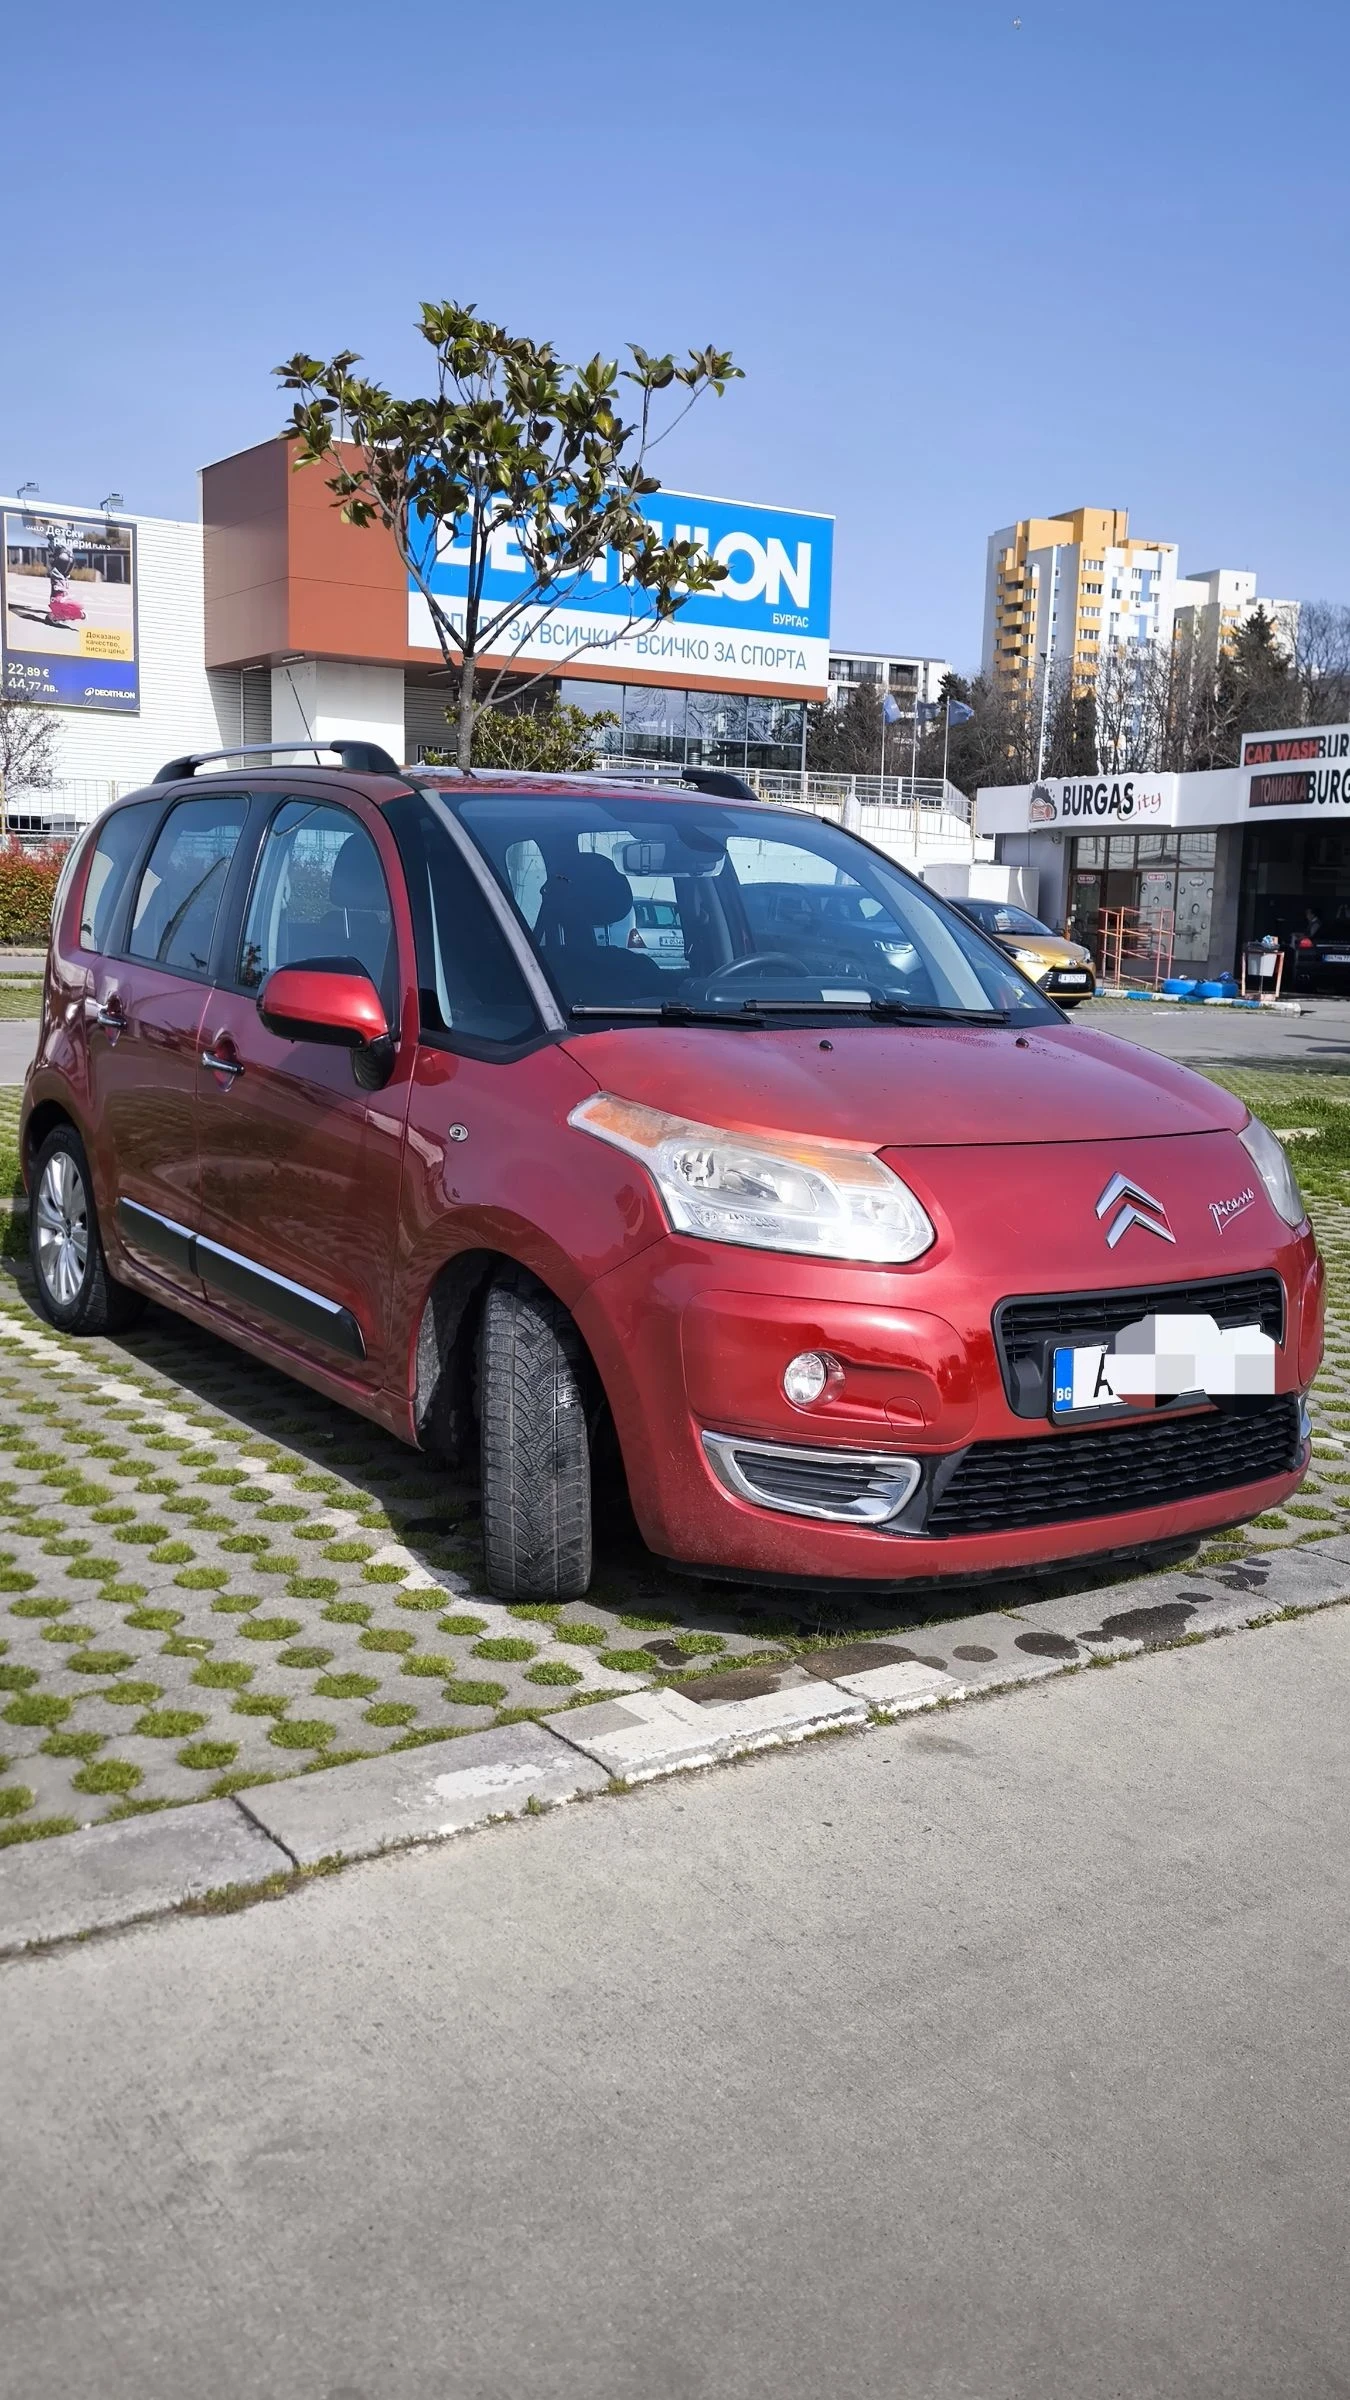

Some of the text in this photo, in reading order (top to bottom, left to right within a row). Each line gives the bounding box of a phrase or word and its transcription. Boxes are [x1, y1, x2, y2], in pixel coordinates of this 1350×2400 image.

[45, 525, 84, 539] Детски
[53, 538, 92, 550] ролери
[772, 612, 809, 628] БУРГАС
[86, 631, 121, 641] Доказано
[508, 618, 534, 643] ЗА
[539, 623, 617, 651] ВСИЧКИ
[636, 634, 709, 660] ВСИЧКО
[714, 641, 736, 664] ЗА
[741, 644, 807, 670] СПОРТА
[7, 662, 50, 678] 22,89 €
[8, 677, 59, 693] 44,77 лв.
[94, 688, 136, 699] DECATHLON
[1245, 744, 1272, 764] CAR
[1276, 740, 1319, 760] WASH
[1062, 782, 1162, 821] BURGAS City
[1208, 1187, 1255, 1236] Picasso
[1056, 1386, 1072, 1402] BG
